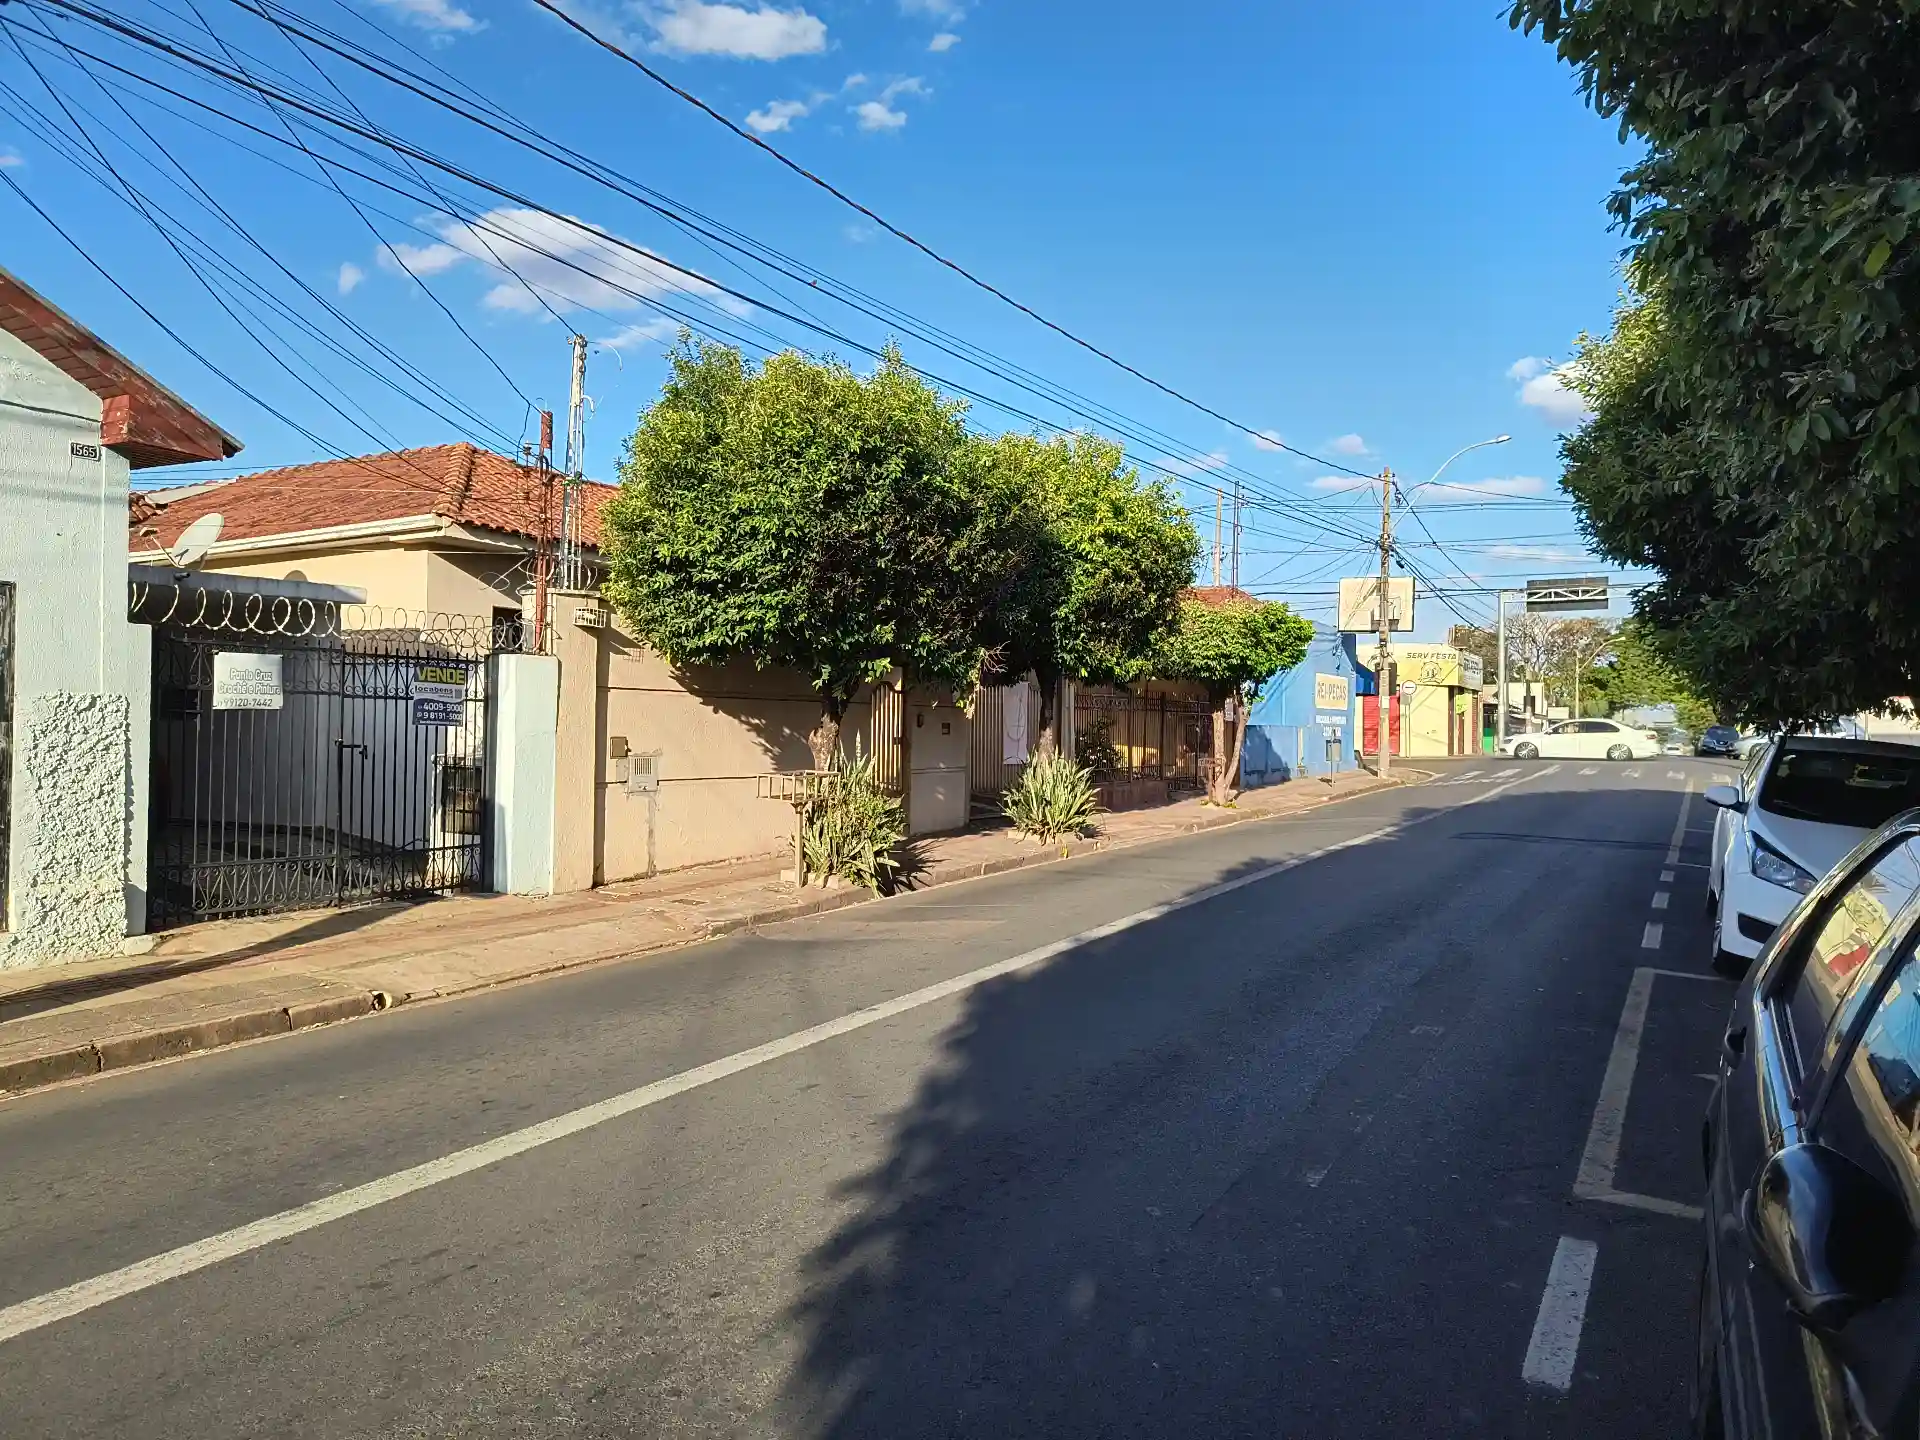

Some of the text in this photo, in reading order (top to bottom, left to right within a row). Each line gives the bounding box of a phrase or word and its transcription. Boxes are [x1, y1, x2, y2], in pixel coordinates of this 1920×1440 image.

[73, 443, 96, 457] 1565
[1430, 652, 1457, 660] FESTA
[255, 668, 273, 682] Cruz
[416, 666, 465, 685] VENDE
[218, 680, 247, 695] Crochê
[247, 684, 254, 695] e
[423, 702, 463, 712] 4009-9000
